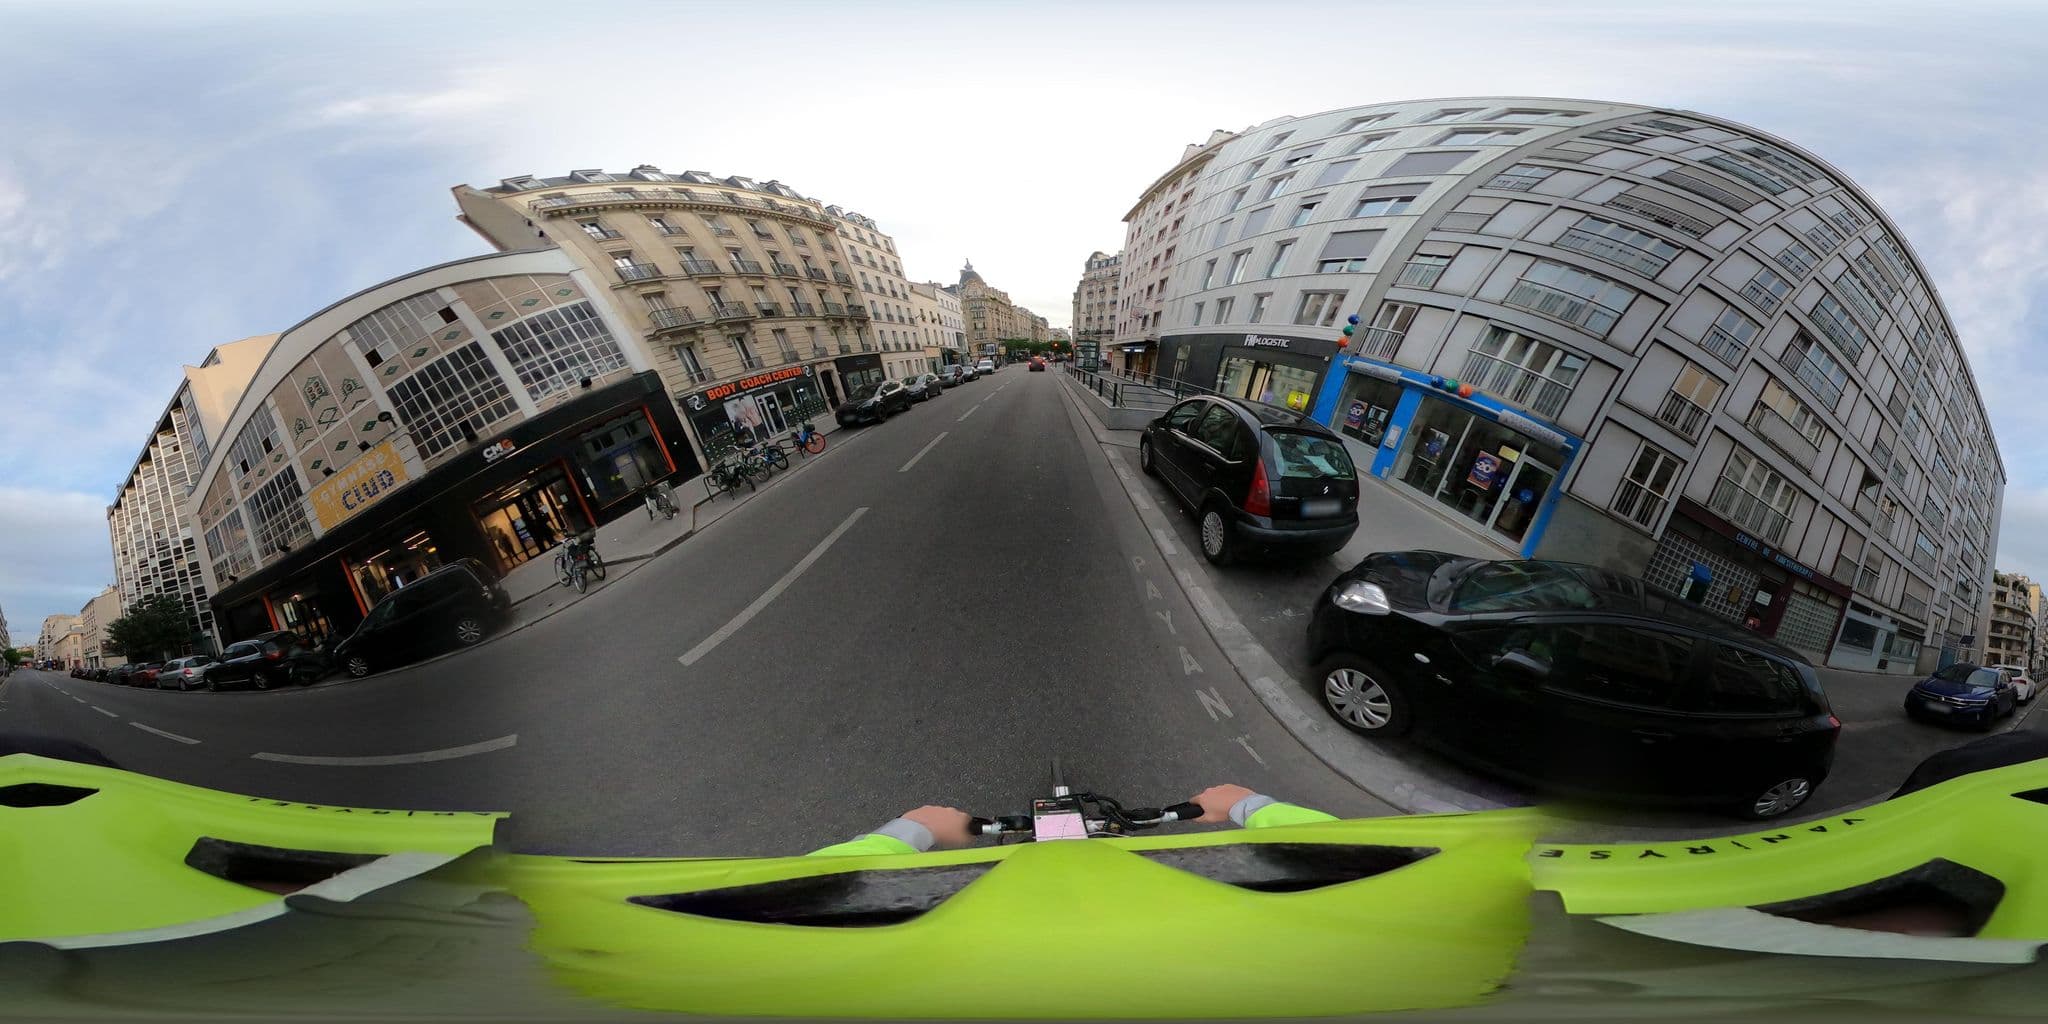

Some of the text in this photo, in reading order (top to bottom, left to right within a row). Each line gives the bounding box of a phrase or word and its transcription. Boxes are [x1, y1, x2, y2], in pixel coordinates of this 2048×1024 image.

[1258, 338, 1290, 348] LOGISTIC
[706, 383, 736, 401] BODY
[740, 373, 772, 390] COACH
[772, 367, 802, 382] CENTER
[483, 439, 513, 458] CMG
[1130, 556, 1269, 770] PAYANT
